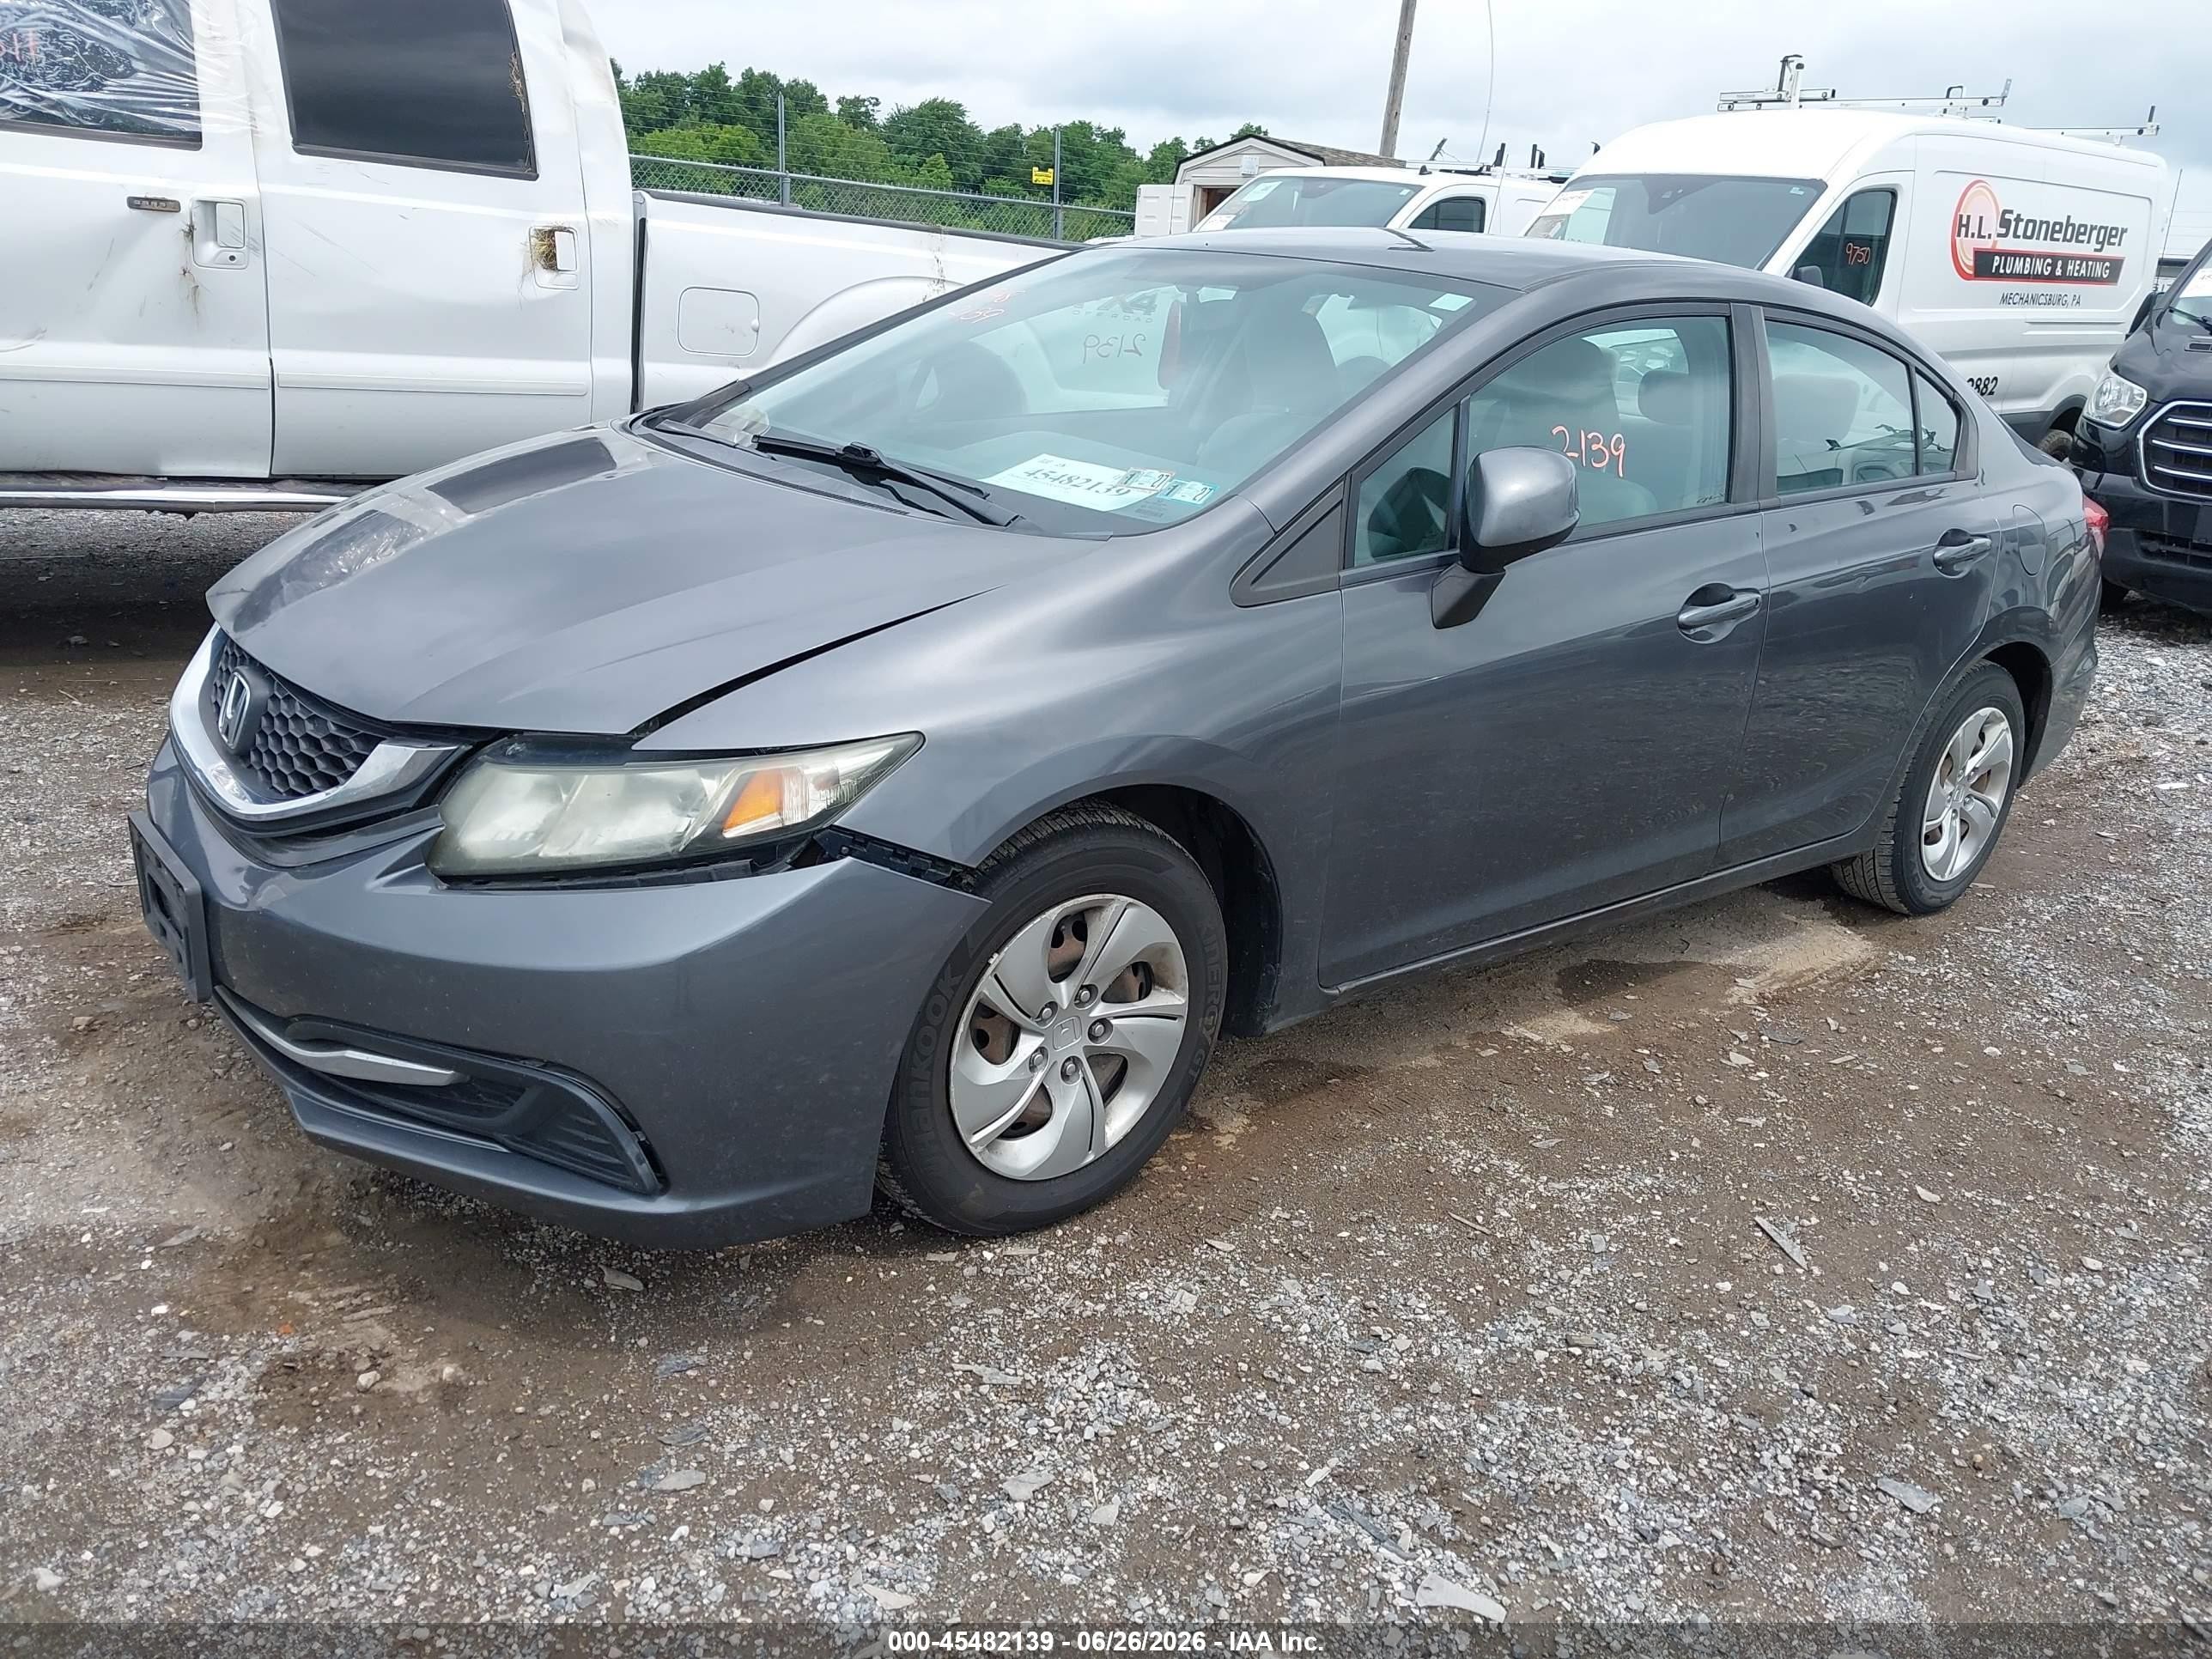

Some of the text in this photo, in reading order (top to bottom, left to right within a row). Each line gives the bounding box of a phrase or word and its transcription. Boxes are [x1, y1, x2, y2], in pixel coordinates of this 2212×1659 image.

[1956, 209, 2129, 252] H.L. Stoneberger
[1845, 242, 1871, 265] 9750
[1992, 255, 2111, 278] PLUMBING & HEATING
[1999, 292, 2081, 307] MECHANICSBURG, PA
[1551, 425, 1626, 477] 2139
